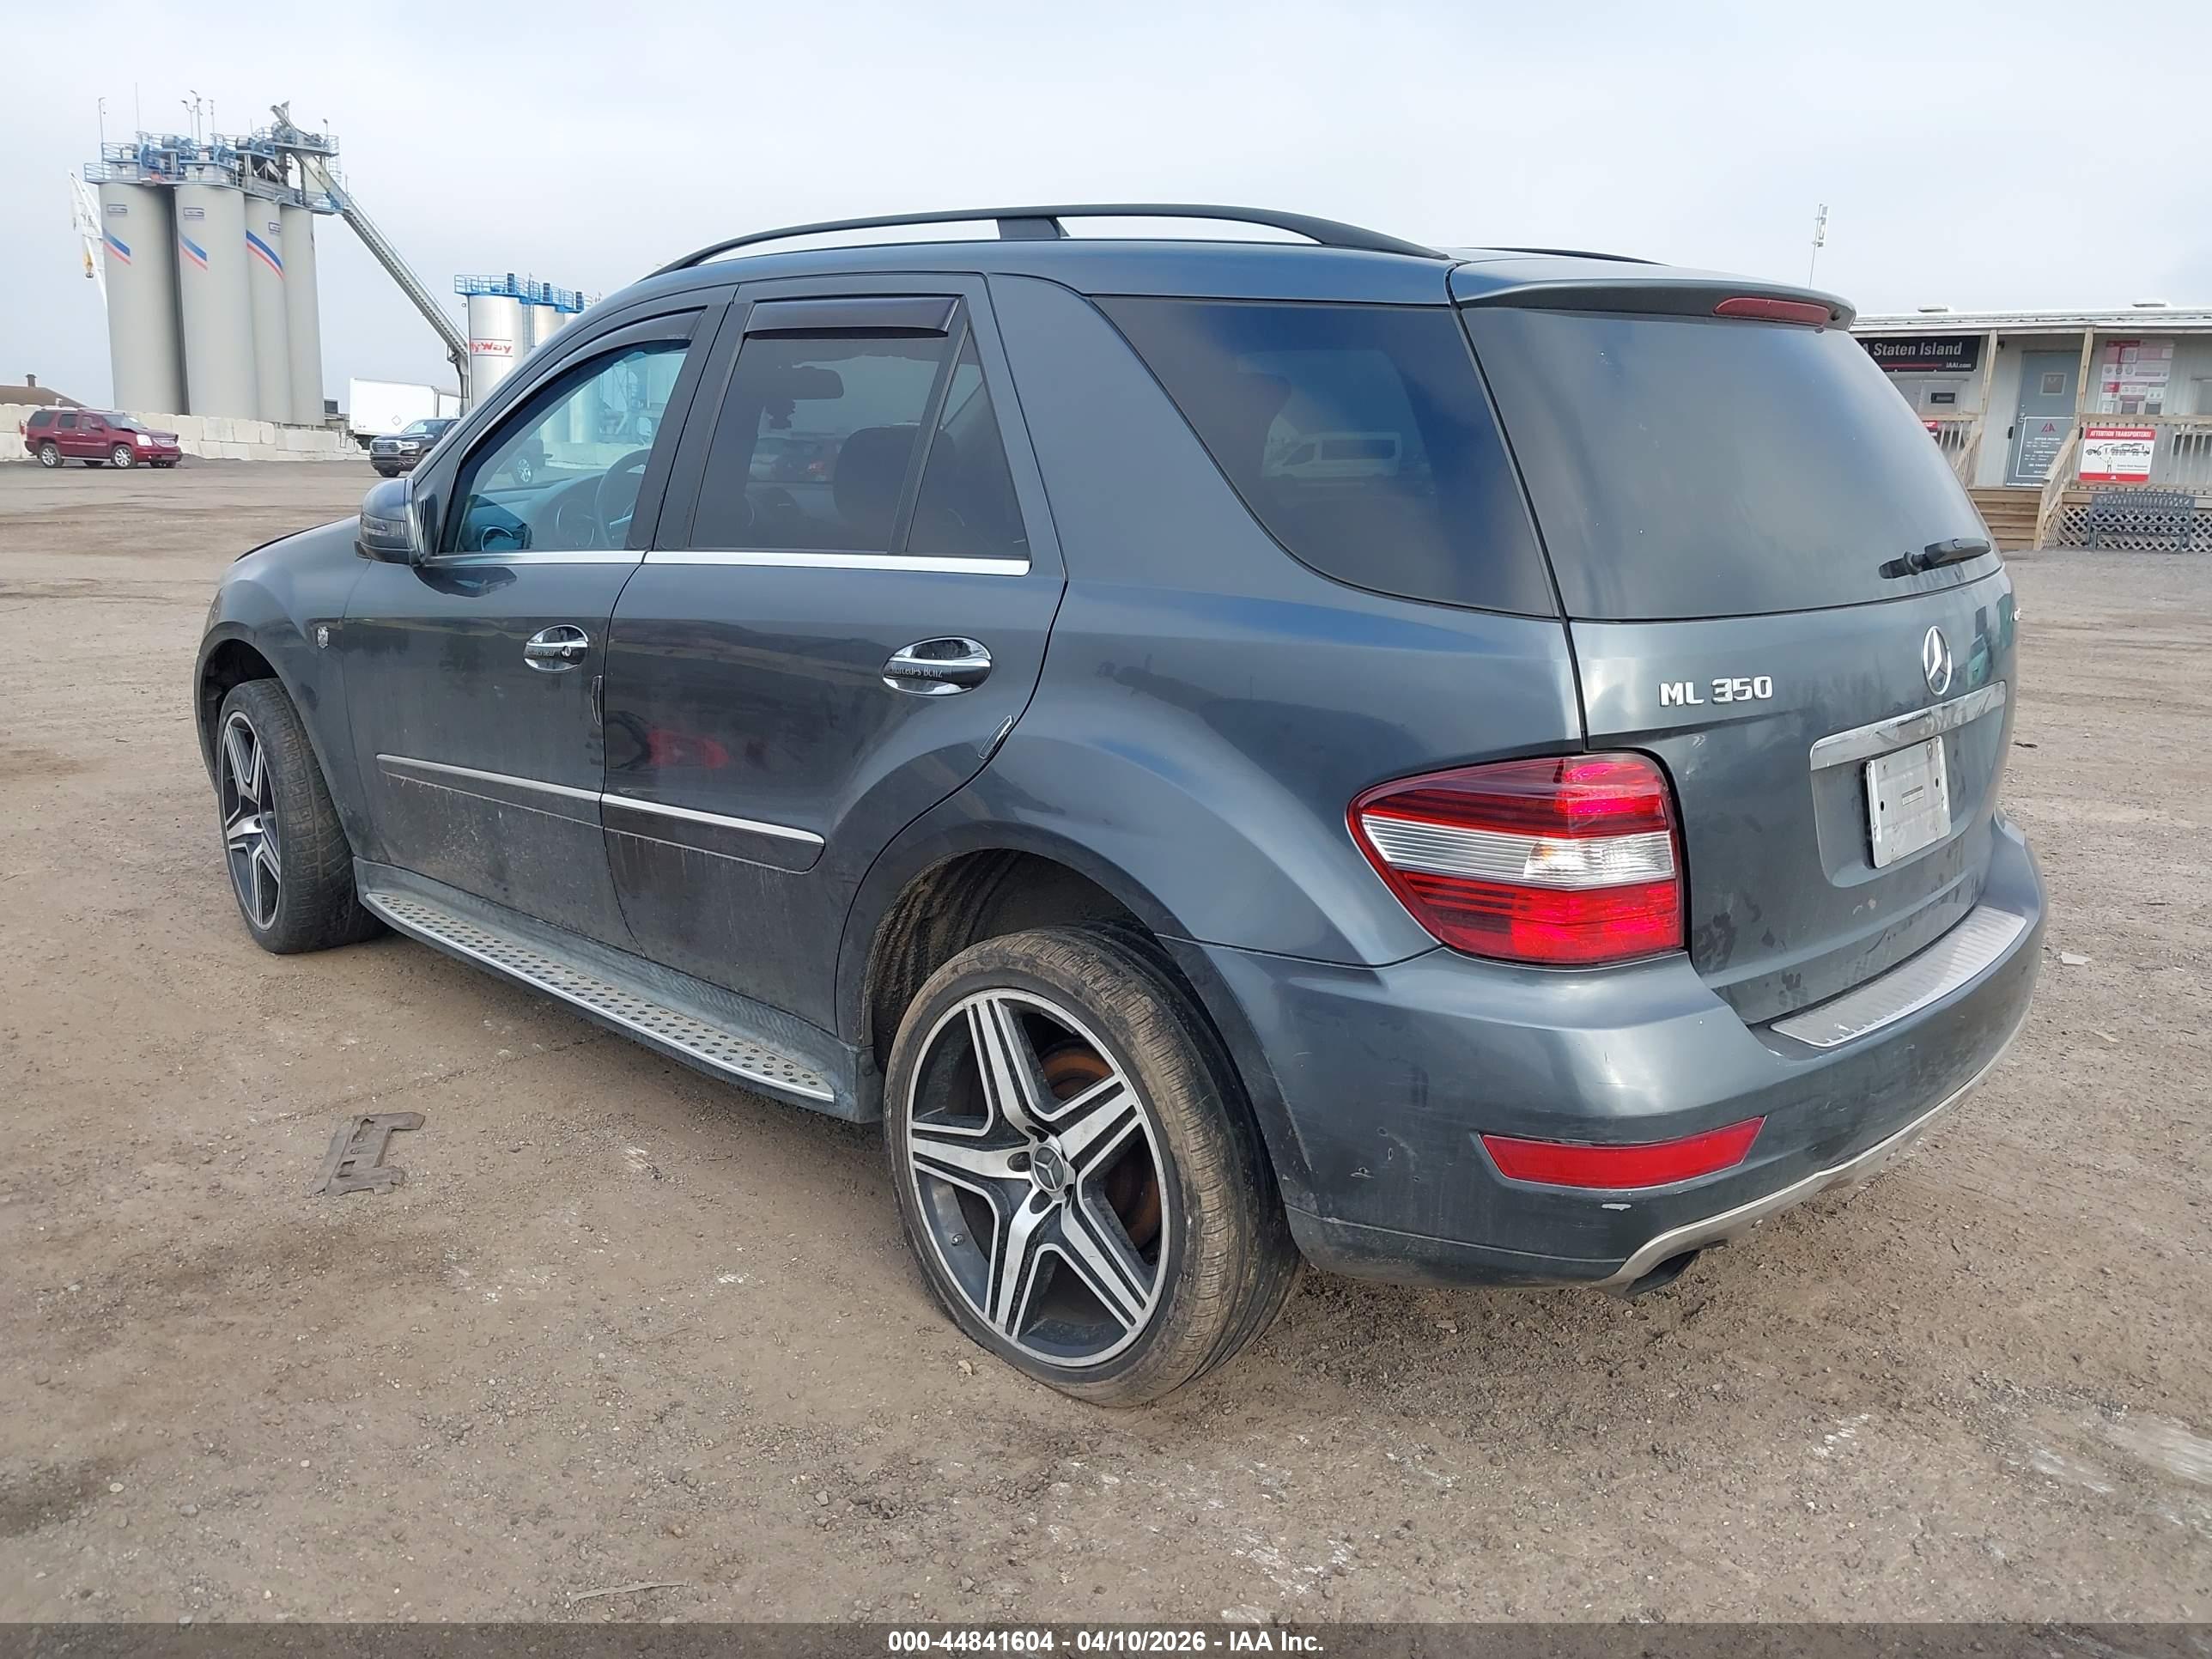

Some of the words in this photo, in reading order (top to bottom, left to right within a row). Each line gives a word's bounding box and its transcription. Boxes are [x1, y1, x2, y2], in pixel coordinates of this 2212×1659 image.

[1873, 343, 1916, 356] Staten
[1919, 341, 1963, 356] Island
[1659, 681, 1705, 708] ML
[1711, 675, 1773, 705] 350
